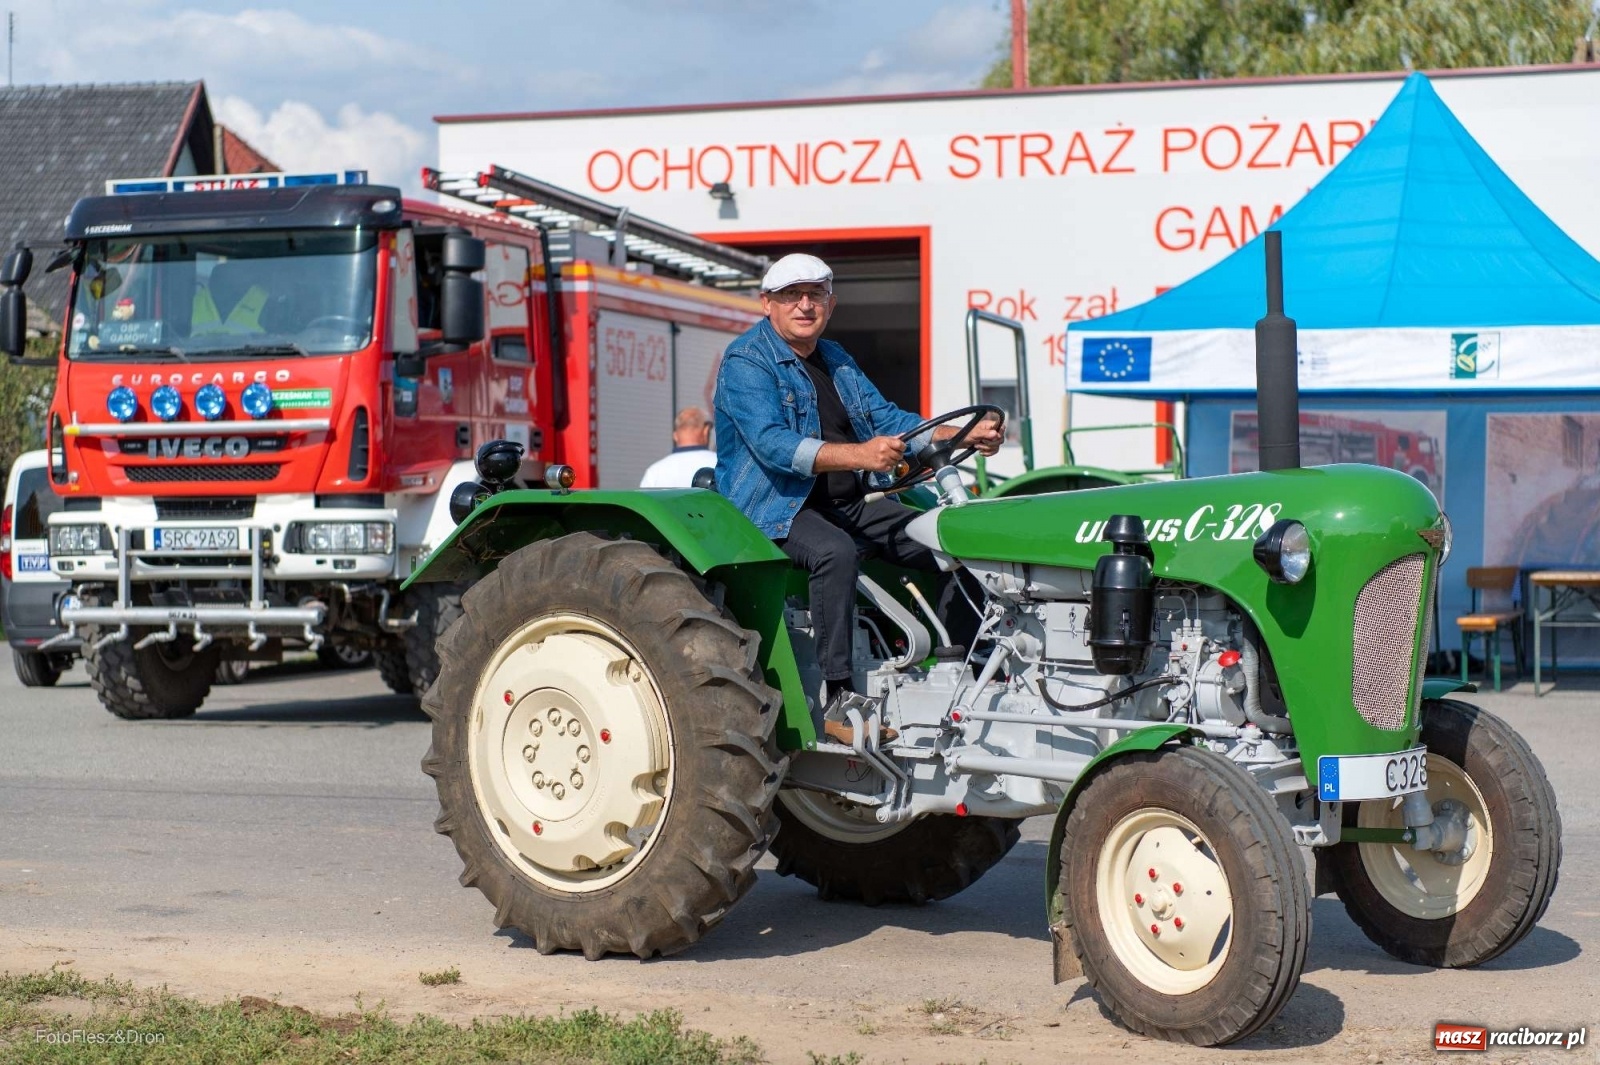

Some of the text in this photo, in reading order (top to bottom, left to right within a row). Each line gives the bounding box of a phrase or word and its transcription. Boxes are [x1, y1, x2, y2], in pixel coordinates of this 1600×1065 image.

[588, 115, 1375, 193] OCHOTNICZA STRAŻ POŻAR
[1155, 204, 1284, 252] GAM
[112, 369, 290, 385] EUROCARGO
[148, 436, 249, 459] IVECO
[1075, 502, 1283, 543] UUS C-328
[1324, 782, 1336, 793] PL
[1385, 753, 1428, 792] C328
